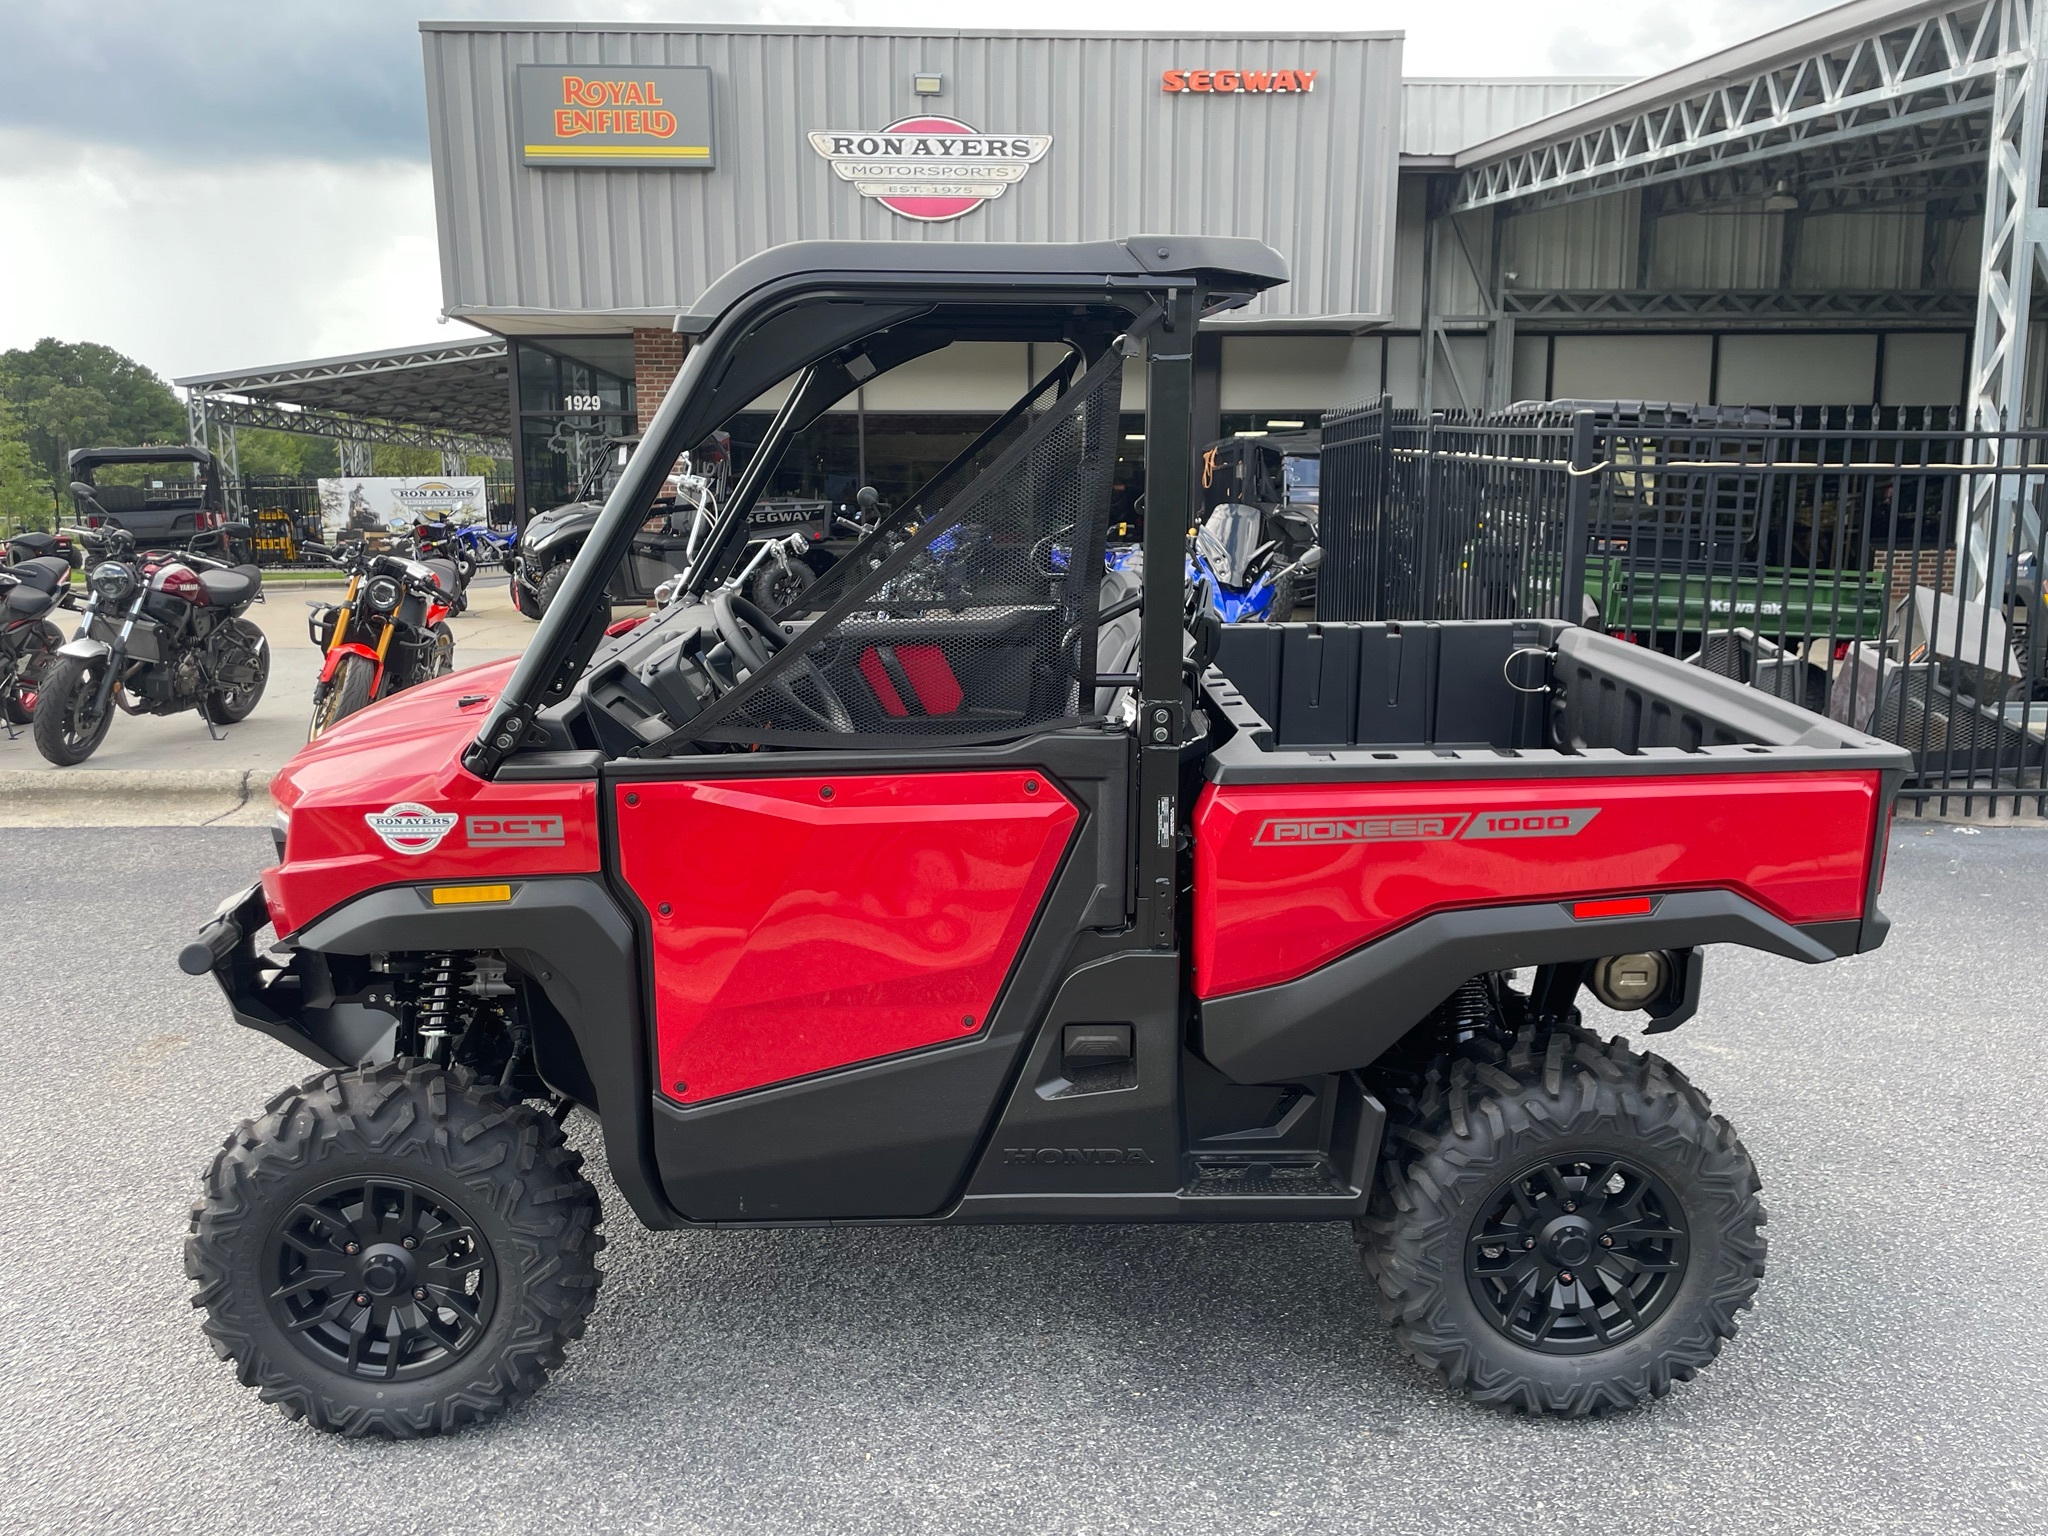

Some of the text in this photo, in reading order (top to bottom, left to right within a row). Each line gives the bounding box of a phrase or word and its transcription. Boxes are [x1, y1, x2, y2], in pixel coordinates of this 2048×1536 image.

[1162, 69, 1319, 92] SEGWAY
[562, 76, 663, 108] ROYAL
[554, 109, 677, 139] ENFIELD
[830, 137, 1032, 158] RON AYERS
[852, 165, 1010, 178] MOTORSPORTS
[888, 185, 973, 195] EST. 1975
[564, 395, 601, 411] 1929
[400, 490, 474, 498] RON AYERS
[1710, 599, 1783, 616] Kawaak
[405, 817, 450, 825] AYERS
[473, 820, 557, 834] DCT
[1274, 815, 1570, 840] PIONEER 1000
[1003, 1147, 1155, 1165] HONDA
